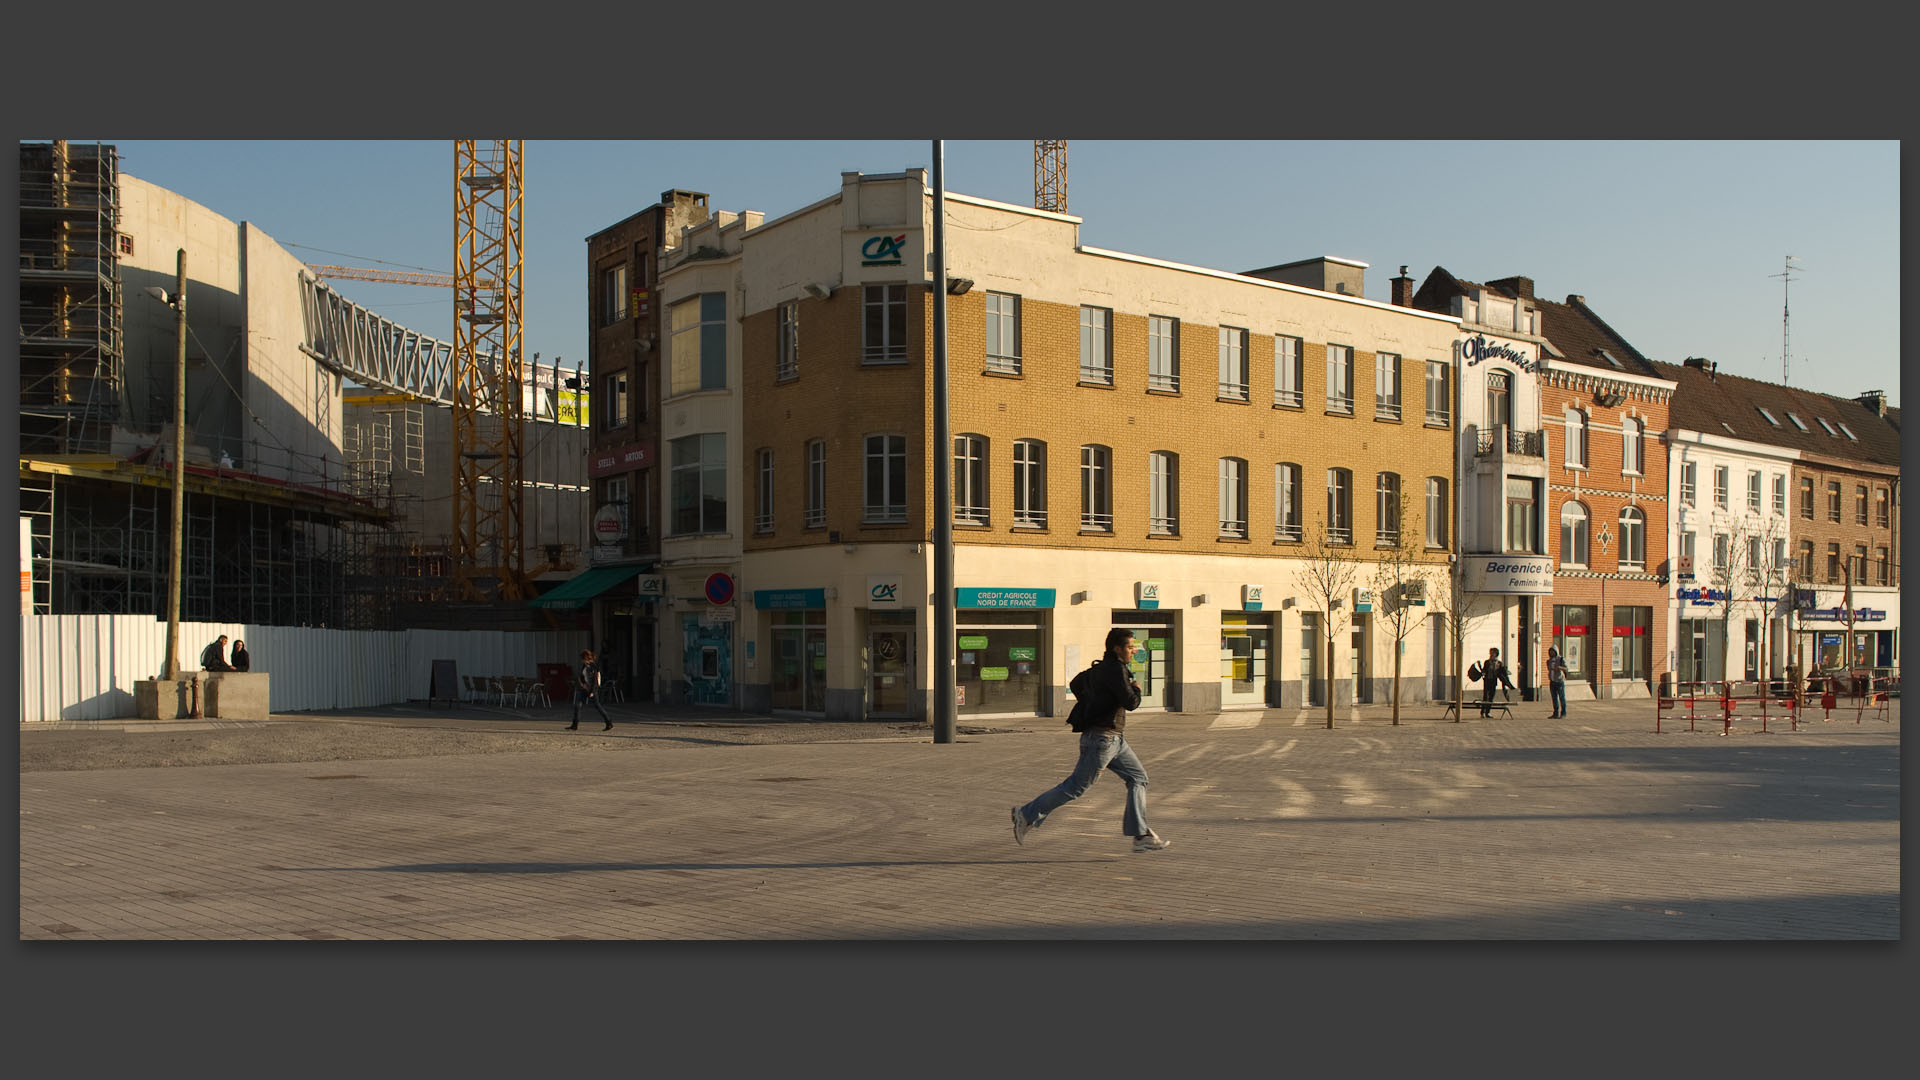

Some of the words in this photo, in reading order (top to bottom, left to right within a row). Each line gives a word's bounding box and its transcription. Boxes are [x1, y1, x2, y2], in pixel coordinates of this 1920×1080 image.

[862, 235, 905, 260] CA
[598, 457, 615, 469] STELLA
[625, 450, 644, 463] ARTOIS
[1487, 562, 1541, 574] Berenice
